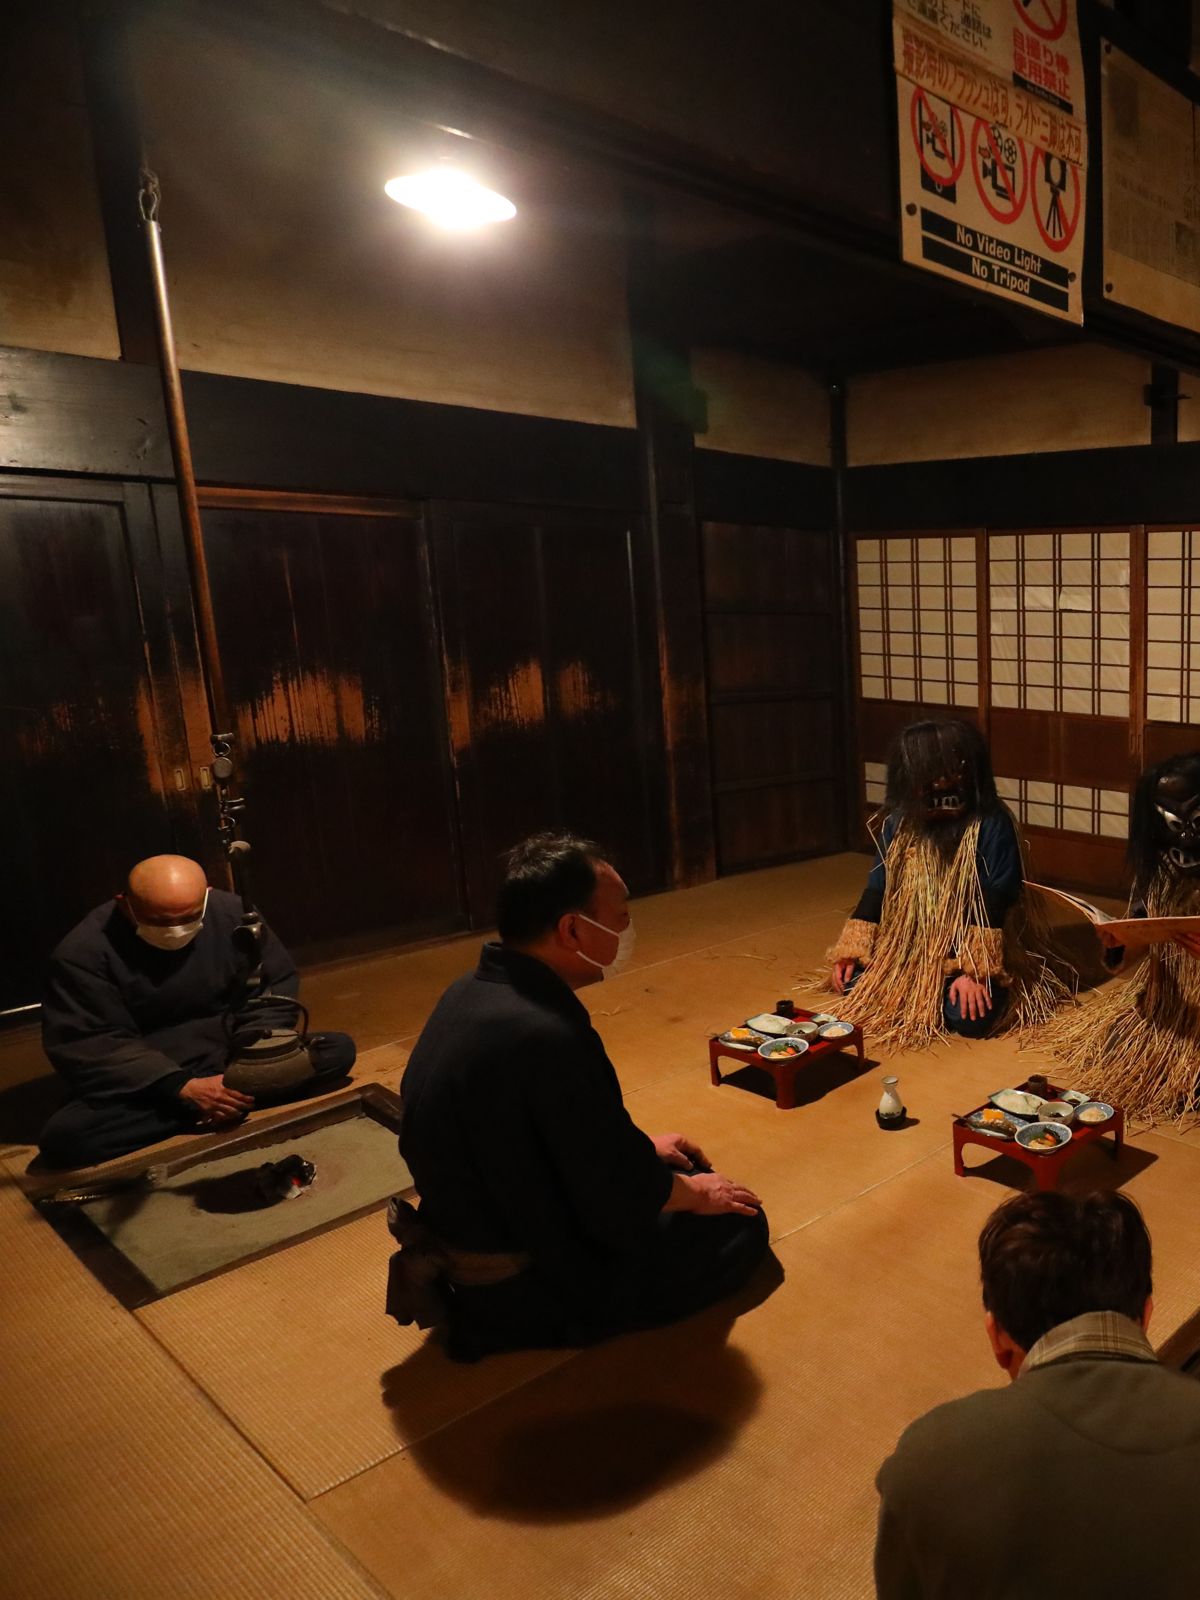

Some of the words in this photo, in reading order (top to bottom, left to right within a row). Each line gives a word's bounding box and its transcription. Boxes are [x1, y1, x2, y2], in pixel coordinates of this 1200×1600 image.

[1013, 48, 1072, 100] 使用禁止
[956, 224, 973, 247] No
[976, 234, 1011, 262] Video
[1014, 246, 1042, 275] Light
[971, 257, 988, 279] No
[992, 263, 1031, 294] Tripod
